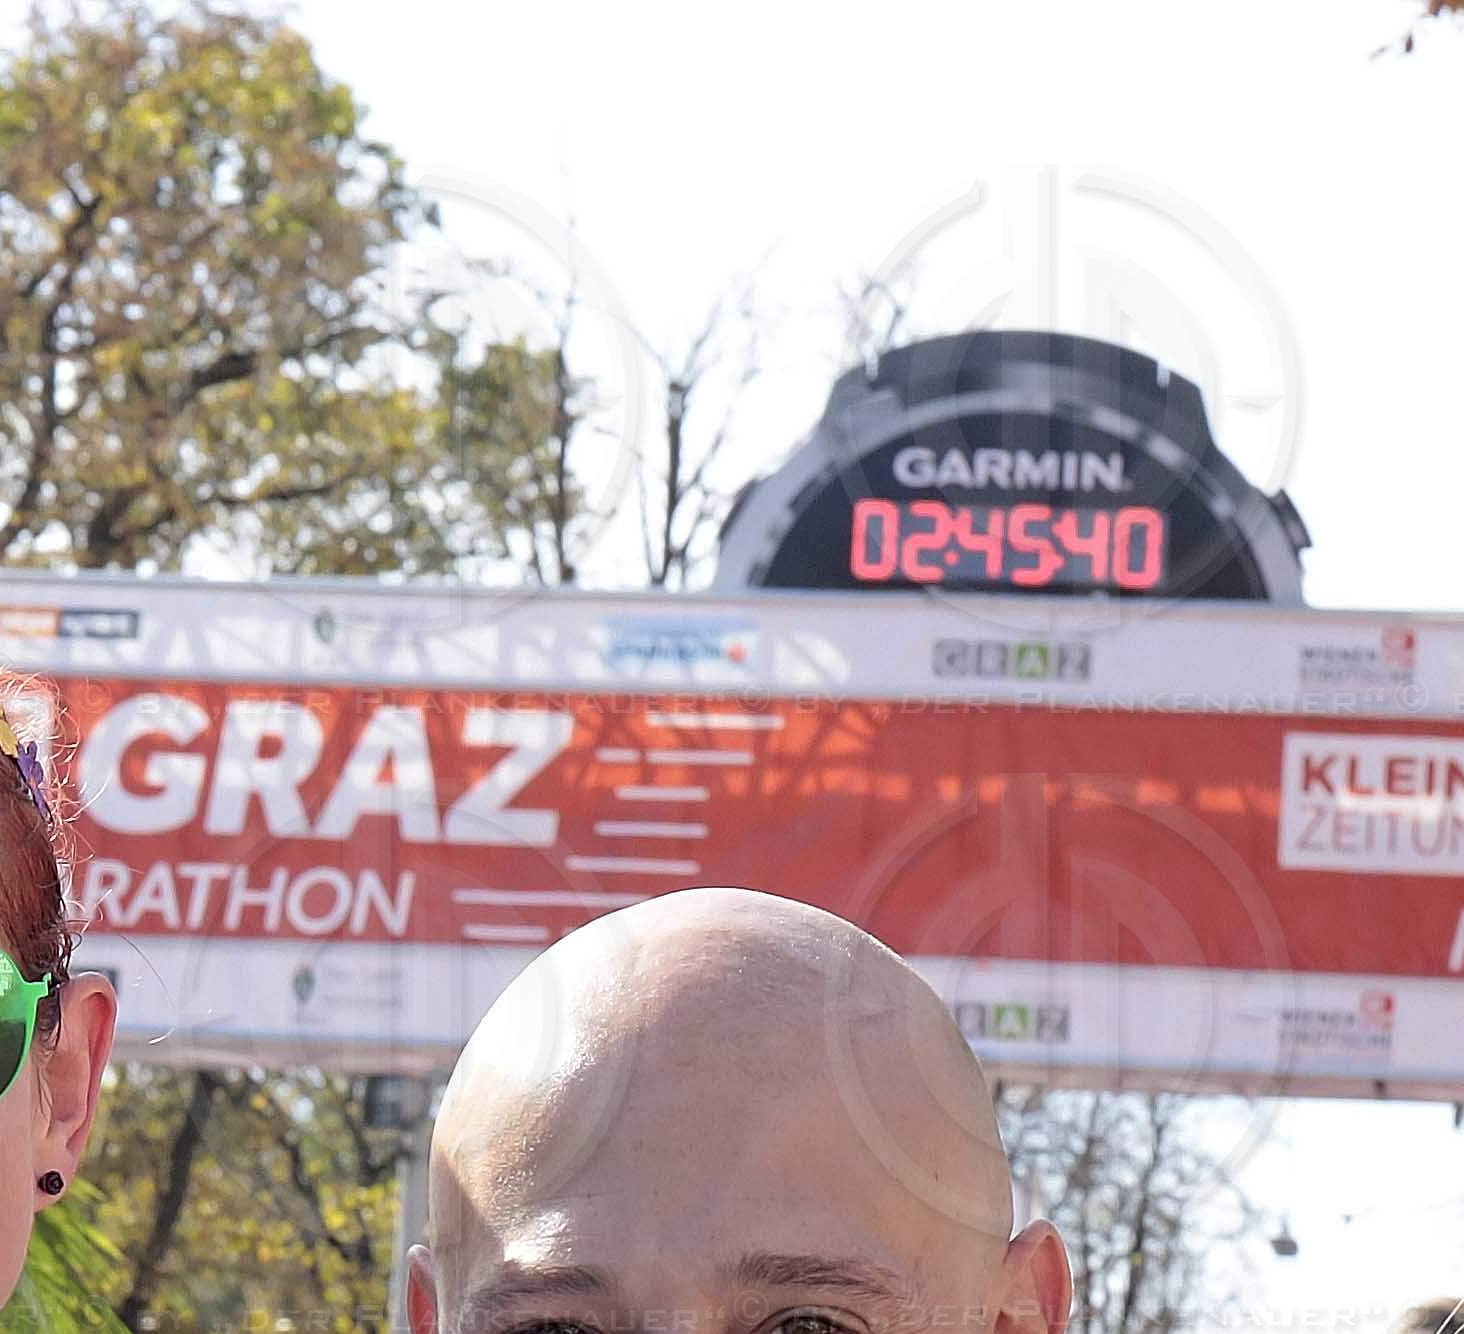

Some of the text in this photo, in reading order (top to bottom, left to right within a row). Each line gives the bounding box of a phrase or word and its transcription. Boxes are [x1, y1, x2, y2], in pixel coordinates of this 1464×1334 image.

[892, 446, 1126, 491] GARMIN
[78, 693, 575, 846] GRAZ
[80, 860, 416, 939] RATHON
